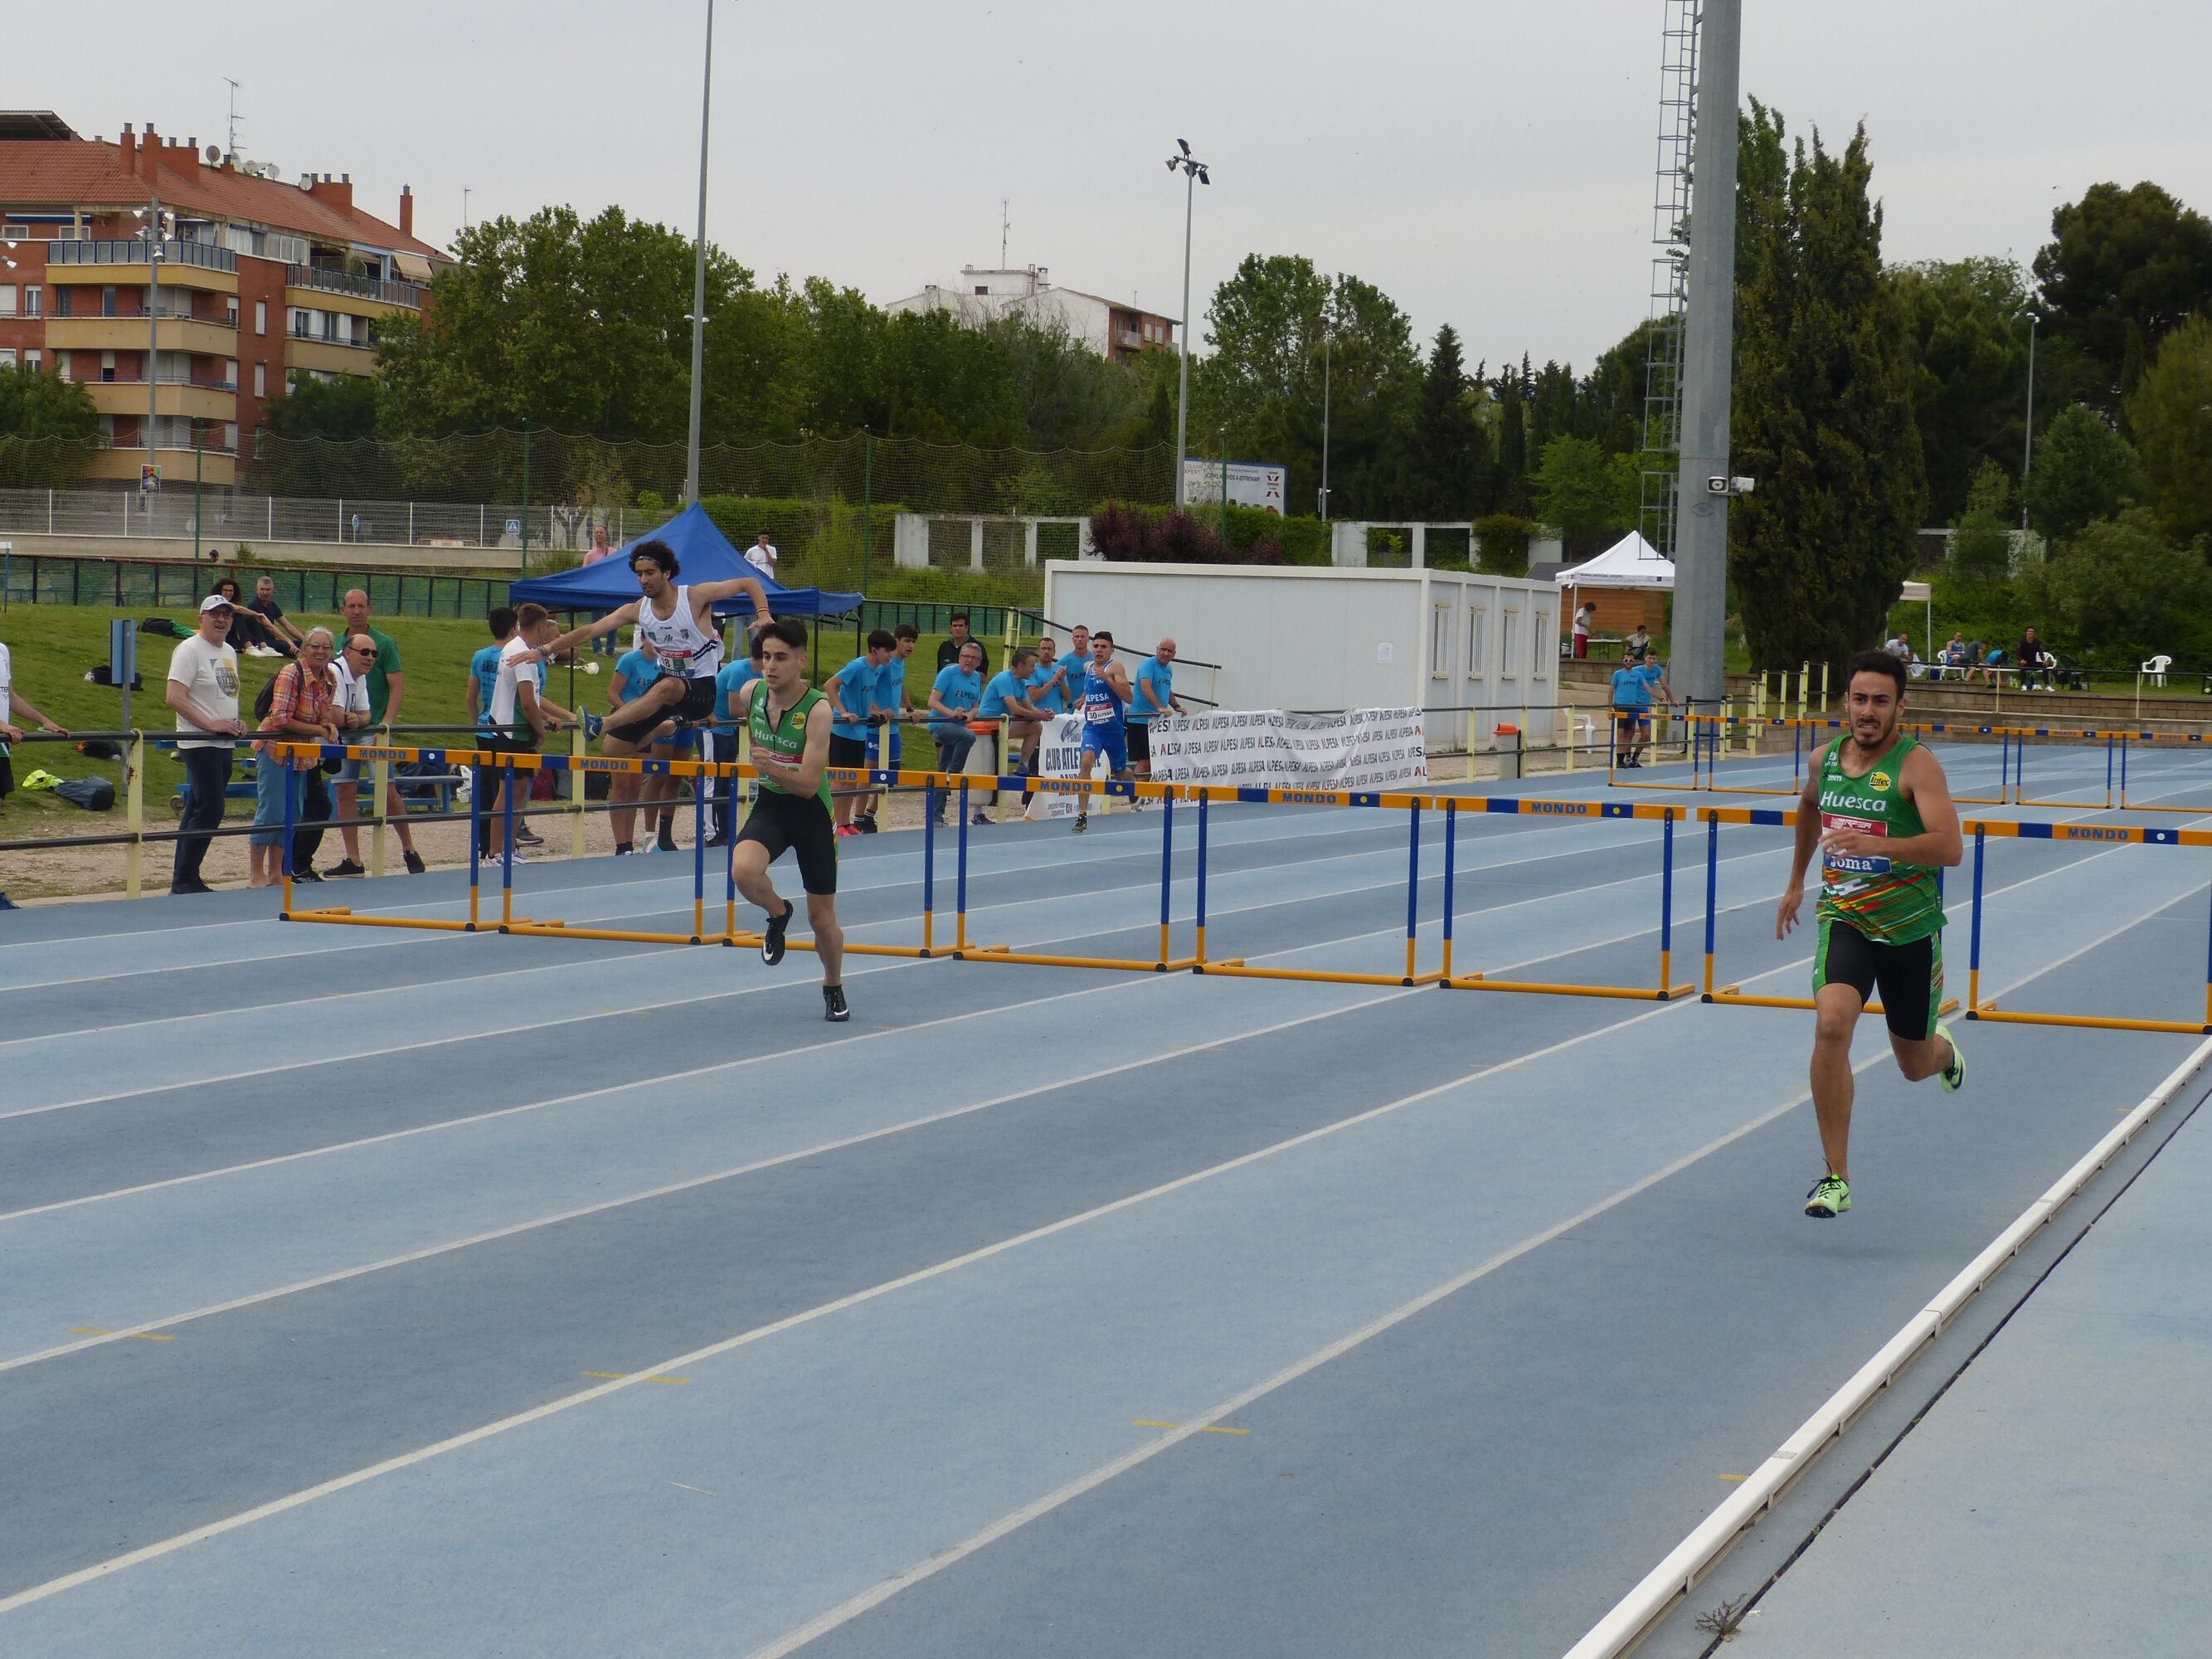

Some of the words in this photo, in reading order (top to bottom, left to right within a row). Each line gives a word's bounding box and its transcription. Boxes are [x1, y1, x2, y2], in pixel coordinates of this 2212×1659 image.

[755, 728, 797, 749] Huesca
[358, 748, 407, 760] MONDO
[1046, 747, 1062, 771] CLUB
[581, 759, 628, 770] MONDO
[827, 771, 858, 780] NDO
[1040, 781, 1092, 792] MONDO
[1282, 792, 1337, 804] MONDO
[1820, 791, 1887, 812] Huesca
[1532, 802, 1587, 814] MONDO
[2068, 827, 2130, 839] MONDO
